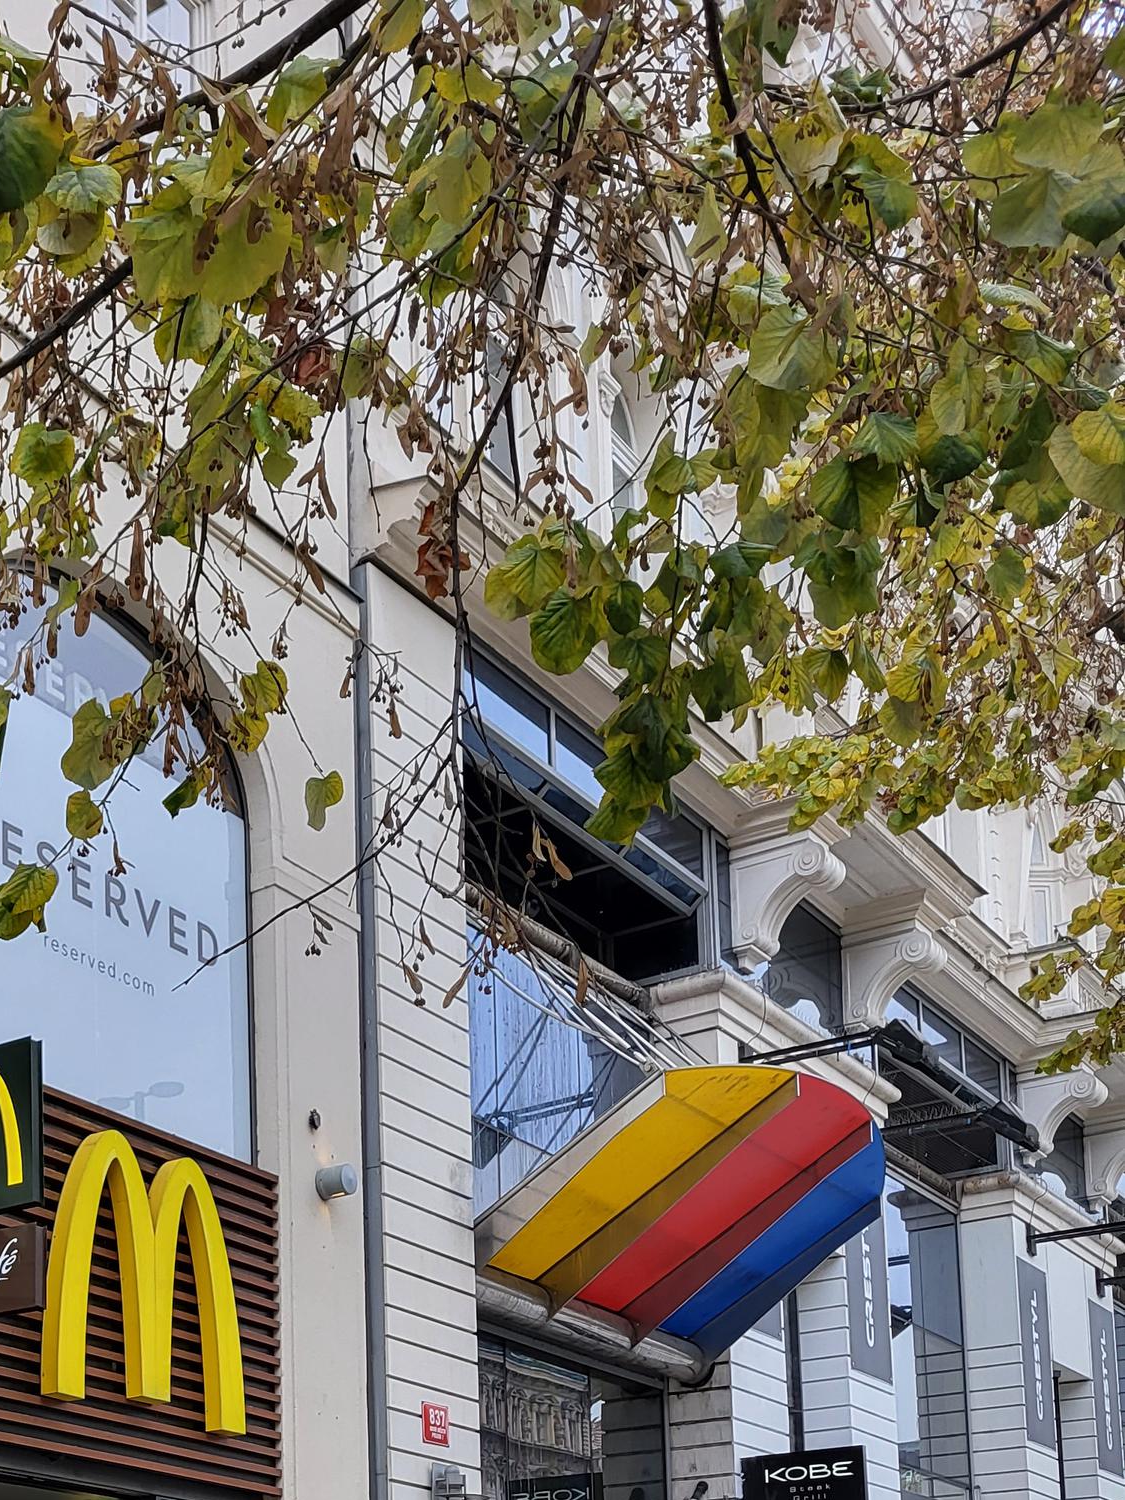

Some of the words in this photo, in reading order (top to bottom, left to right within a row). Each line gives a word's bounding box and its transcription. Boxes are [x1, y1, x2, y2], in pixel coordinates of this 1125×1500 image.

[43, 933, 156, 997] reserved.com
[1030, 1289, 1044, 1422] CRESTYL
[429, 1408, 446, 1427] 837
[764, 1460, 854, 1484] KOBE
